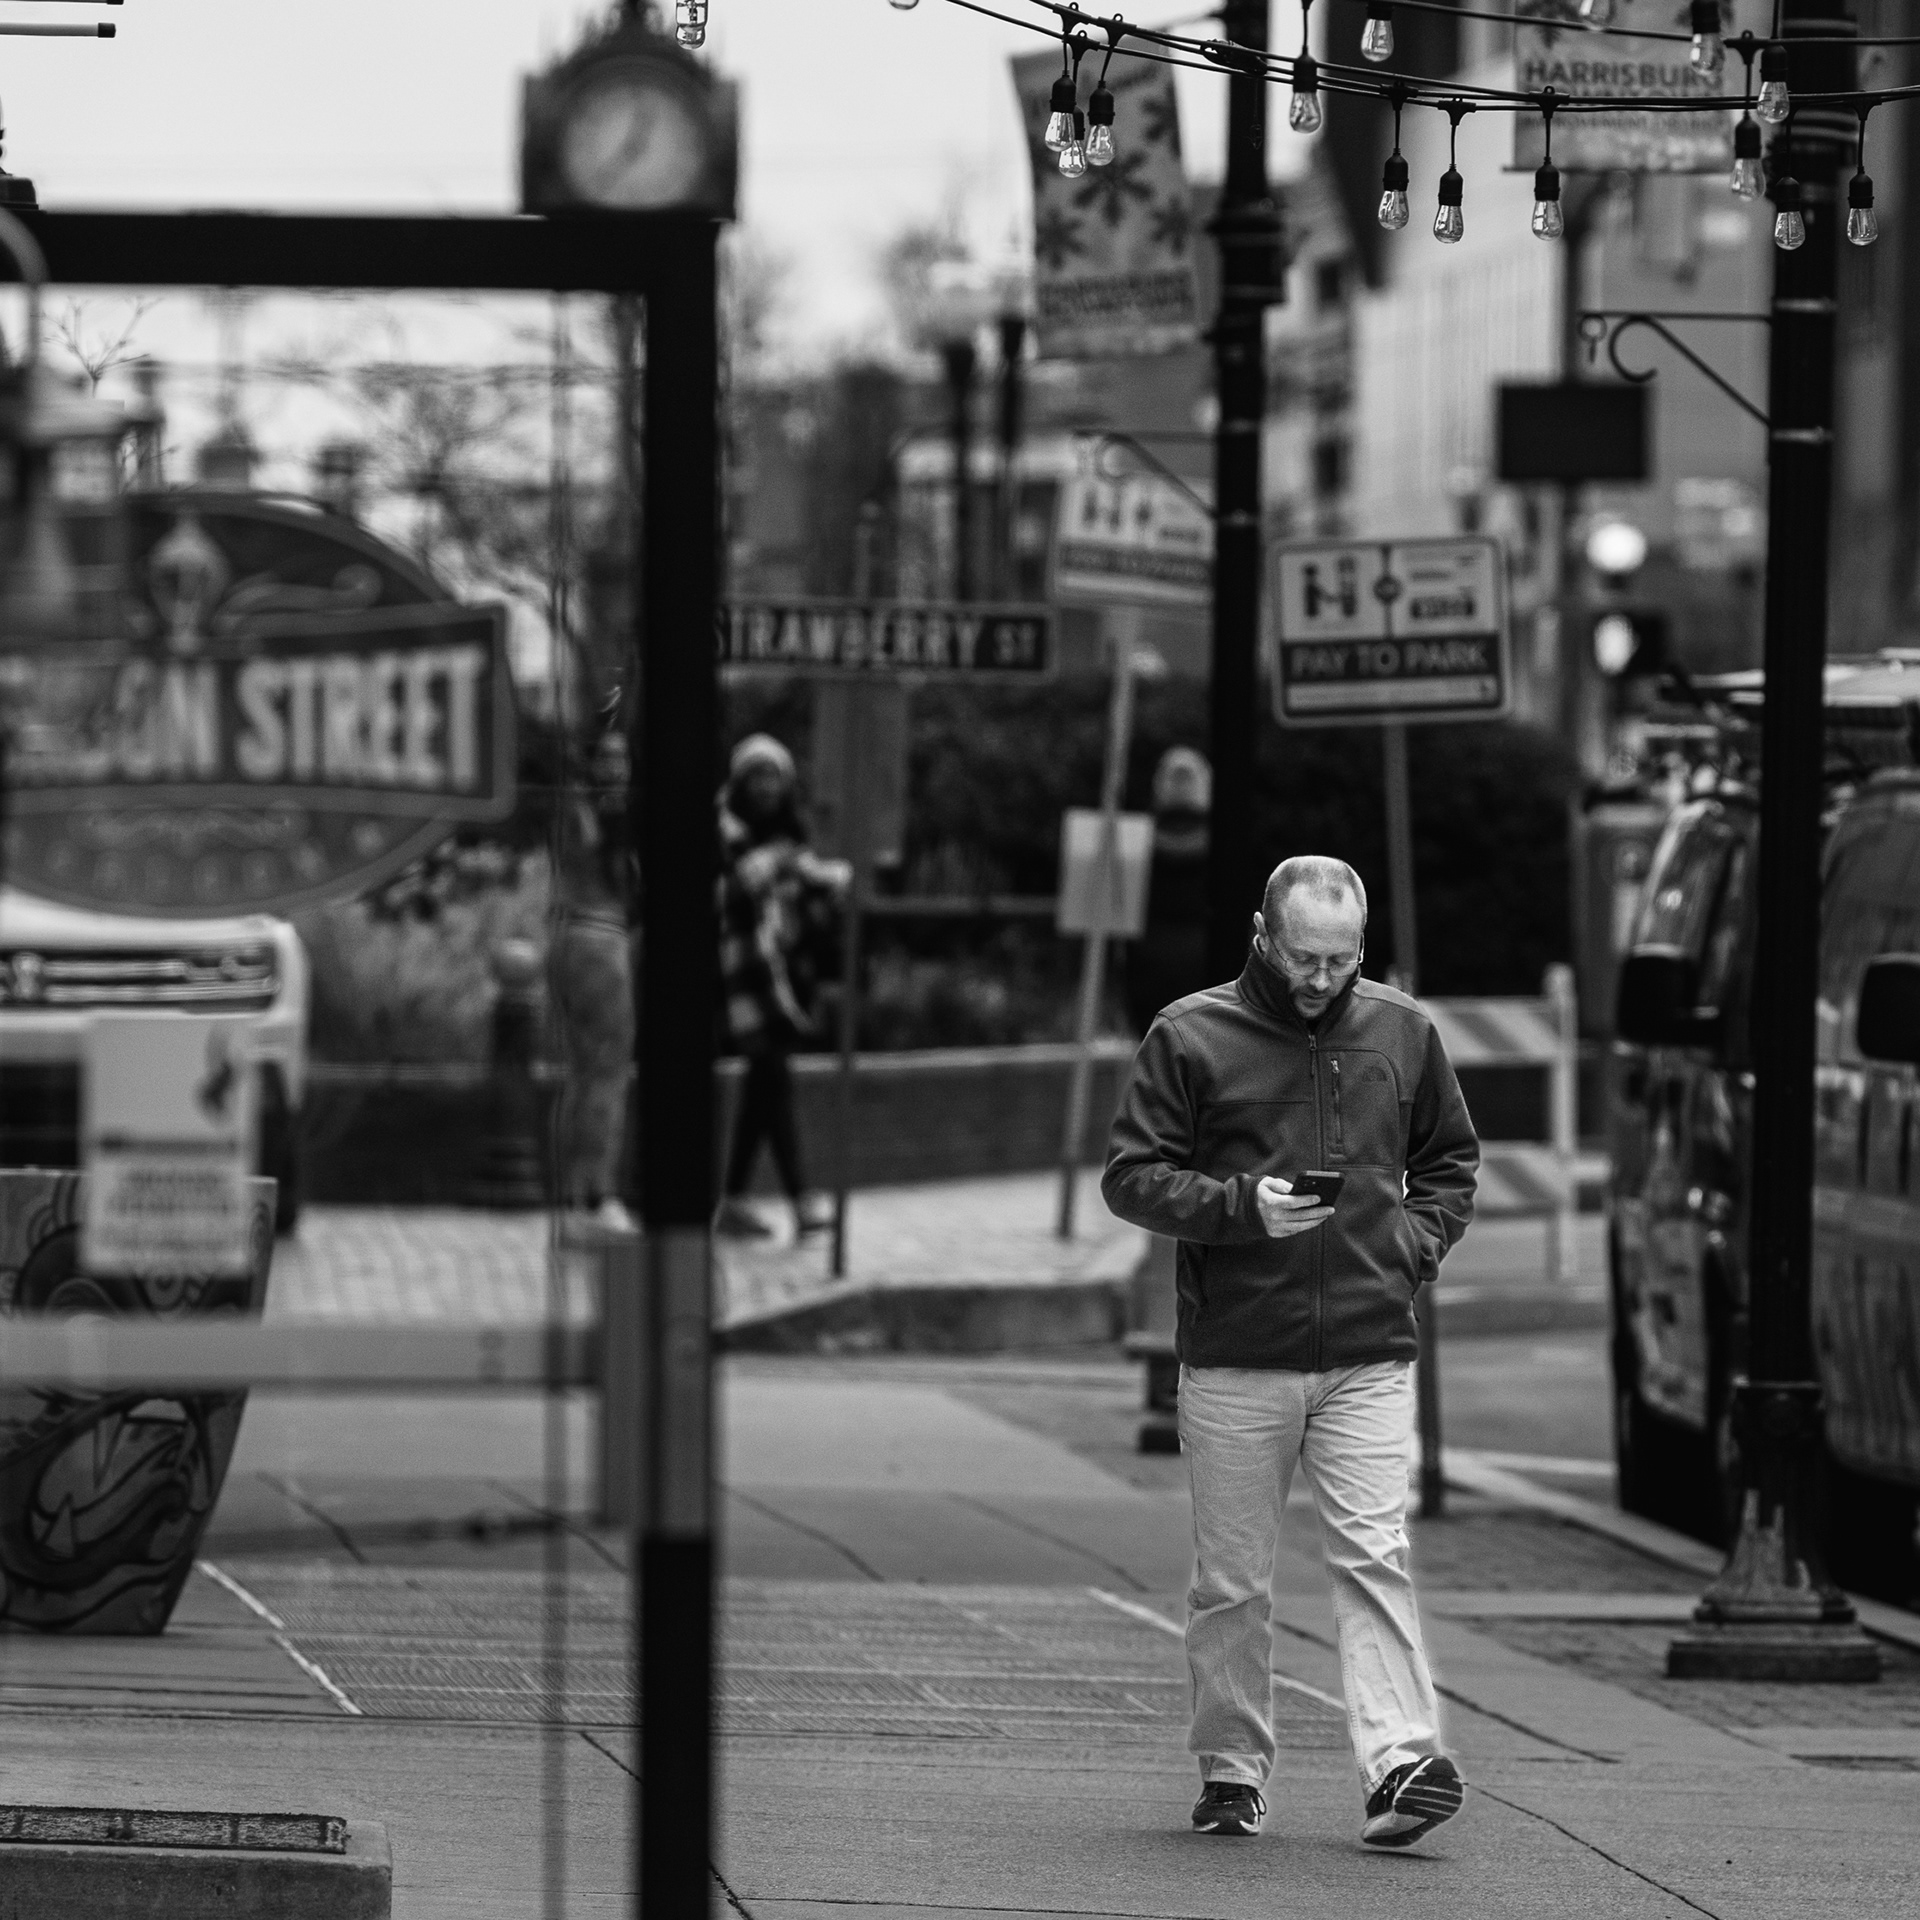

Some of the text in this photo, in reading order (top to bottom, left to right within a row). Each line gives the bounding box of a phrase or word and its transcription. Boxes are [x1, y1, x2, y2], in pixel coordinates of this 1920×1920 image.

[1525, 60, 1724, 88] HARRISBURG
[994, 620, 1037, 664] ST
[1292, 640, 1487, 676] PAY TO PARK
[236, 645, 487, 790] STREET
